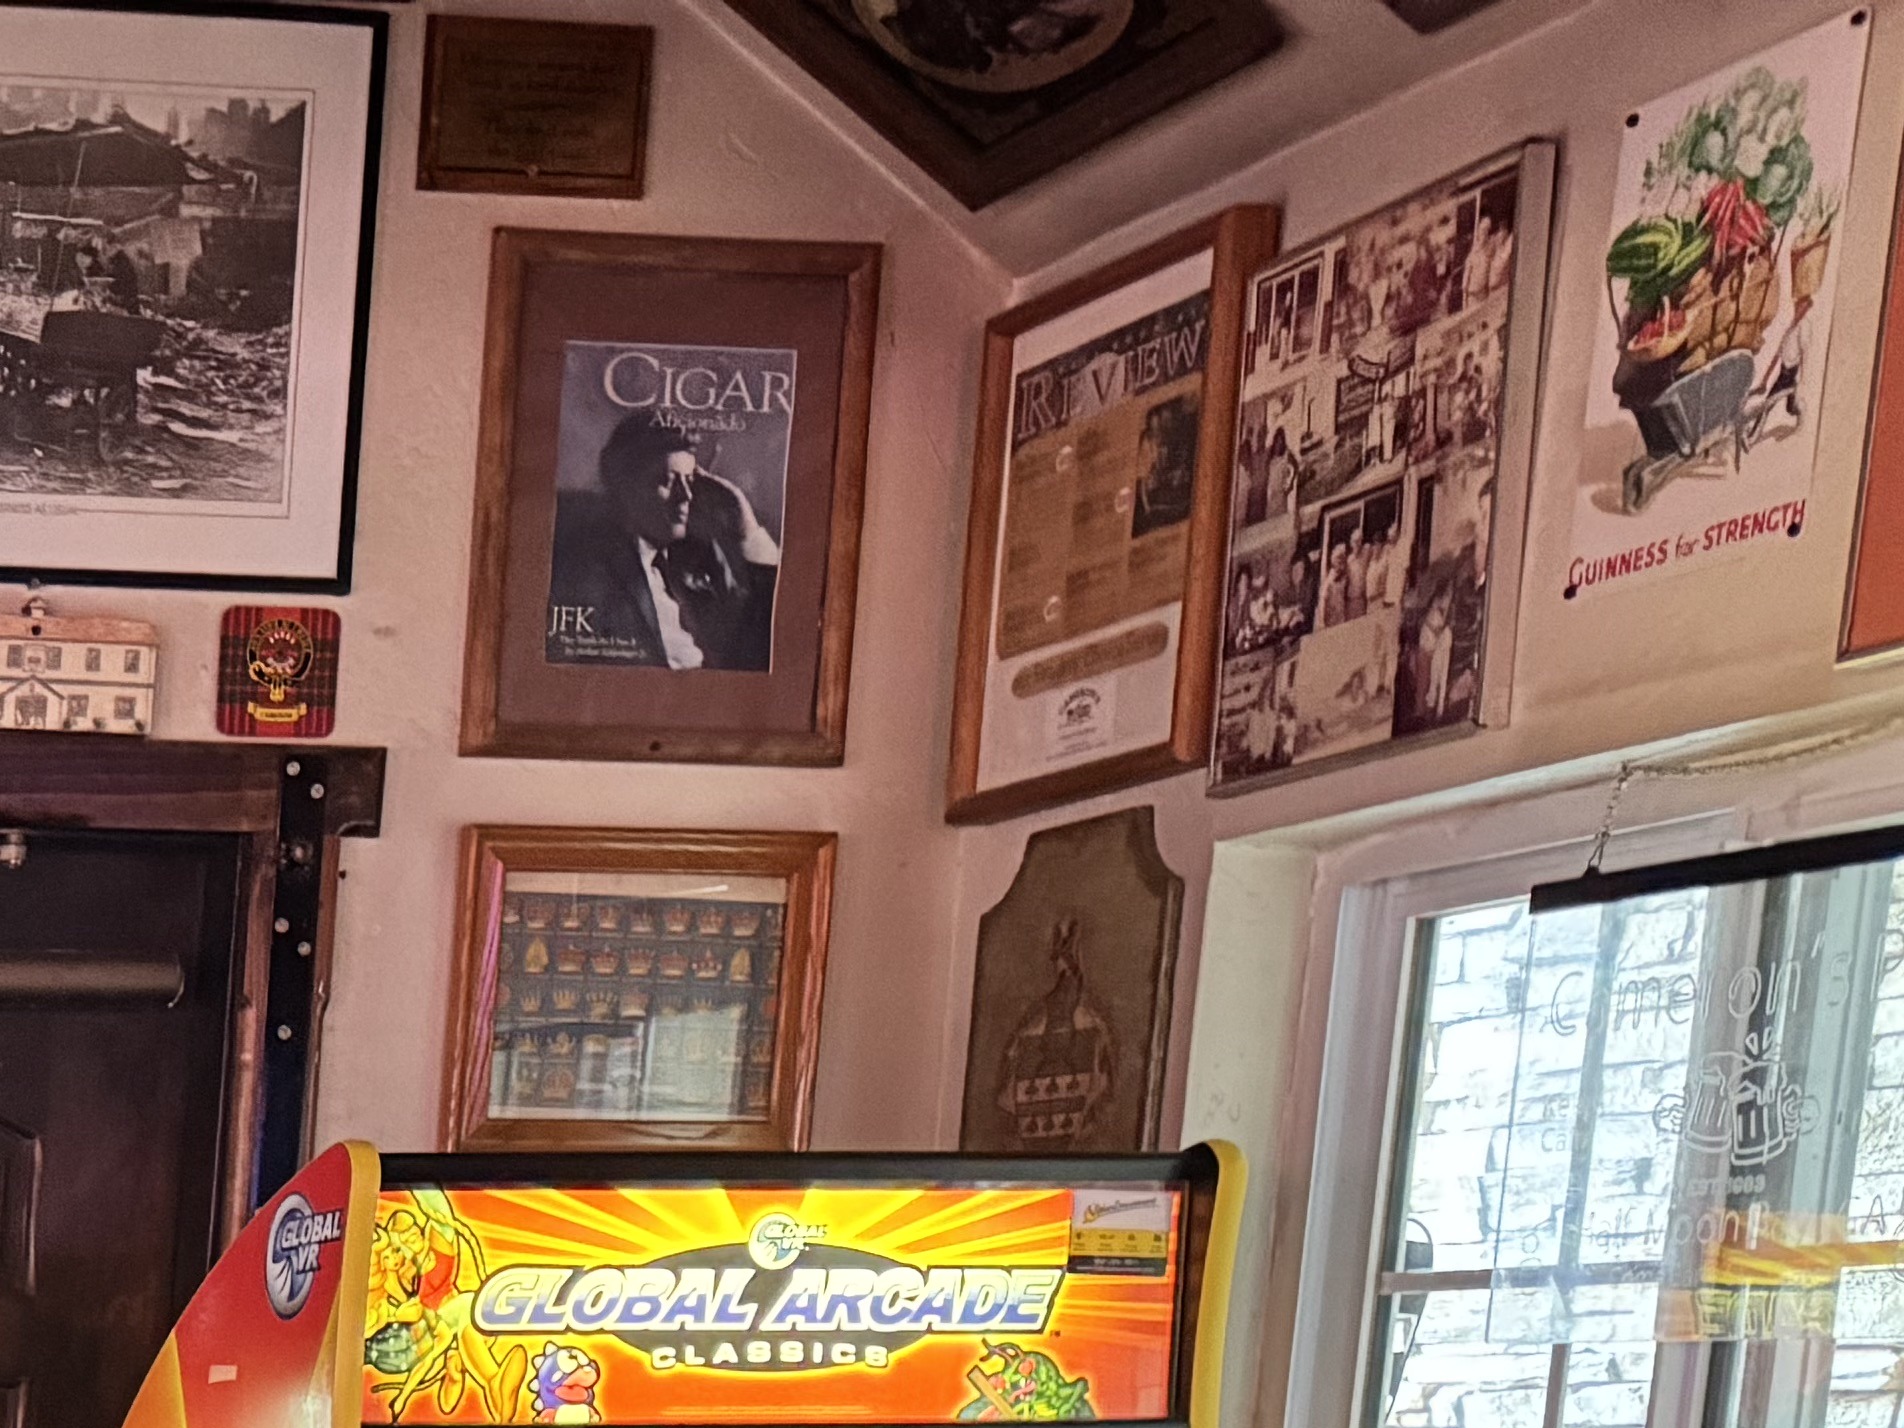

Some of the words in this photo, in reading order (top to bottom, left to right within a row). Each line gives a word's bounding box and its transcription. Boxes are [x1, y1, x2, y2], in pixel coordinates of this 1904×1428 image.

[603, 351, 793, 414] CIGAR
[1569, 538, 1669, 589] GUINNESS
[1675, 532, 1700, 559] for
[1702, 498, 1807, 552] STRENGTH
[548, 605, 596, 637] JFK
[282, 1208, 342, 1248] GLOBAL
[295, 1247, 322, 1274] VR
[474, 1266, 757, 1333] GLOBAL
[759, 1266, 1065, 1333] ARCADE
[651, 1341, 890, 1370] CLASSICS
